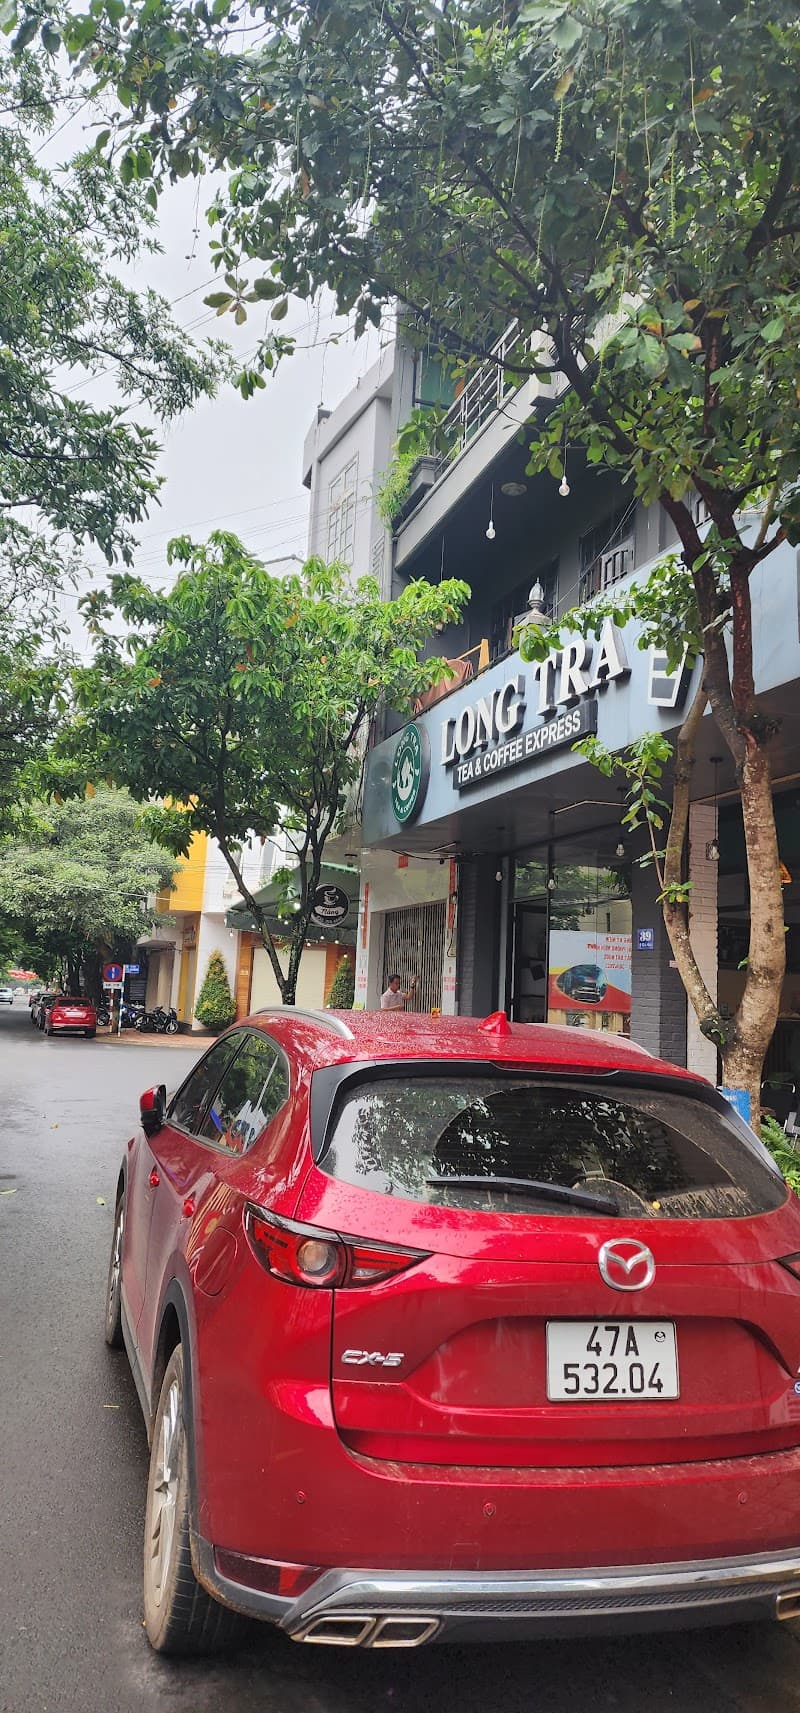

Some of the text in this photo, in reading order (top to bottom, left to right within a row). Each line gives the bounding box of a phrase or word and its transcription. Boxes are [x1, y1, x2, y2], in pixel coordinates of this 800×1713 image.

[440, 616, 630, 766] LONG TRA
[457, 710, 582, 784] TEA & COFFEE EXPRESS
[639, 930, 652, 942] 39
[586, 1325, 640, 1357] 47A
[341, 1349, 405, 1367] CX-5
[563, 1362, 664, 1395] 532.04
